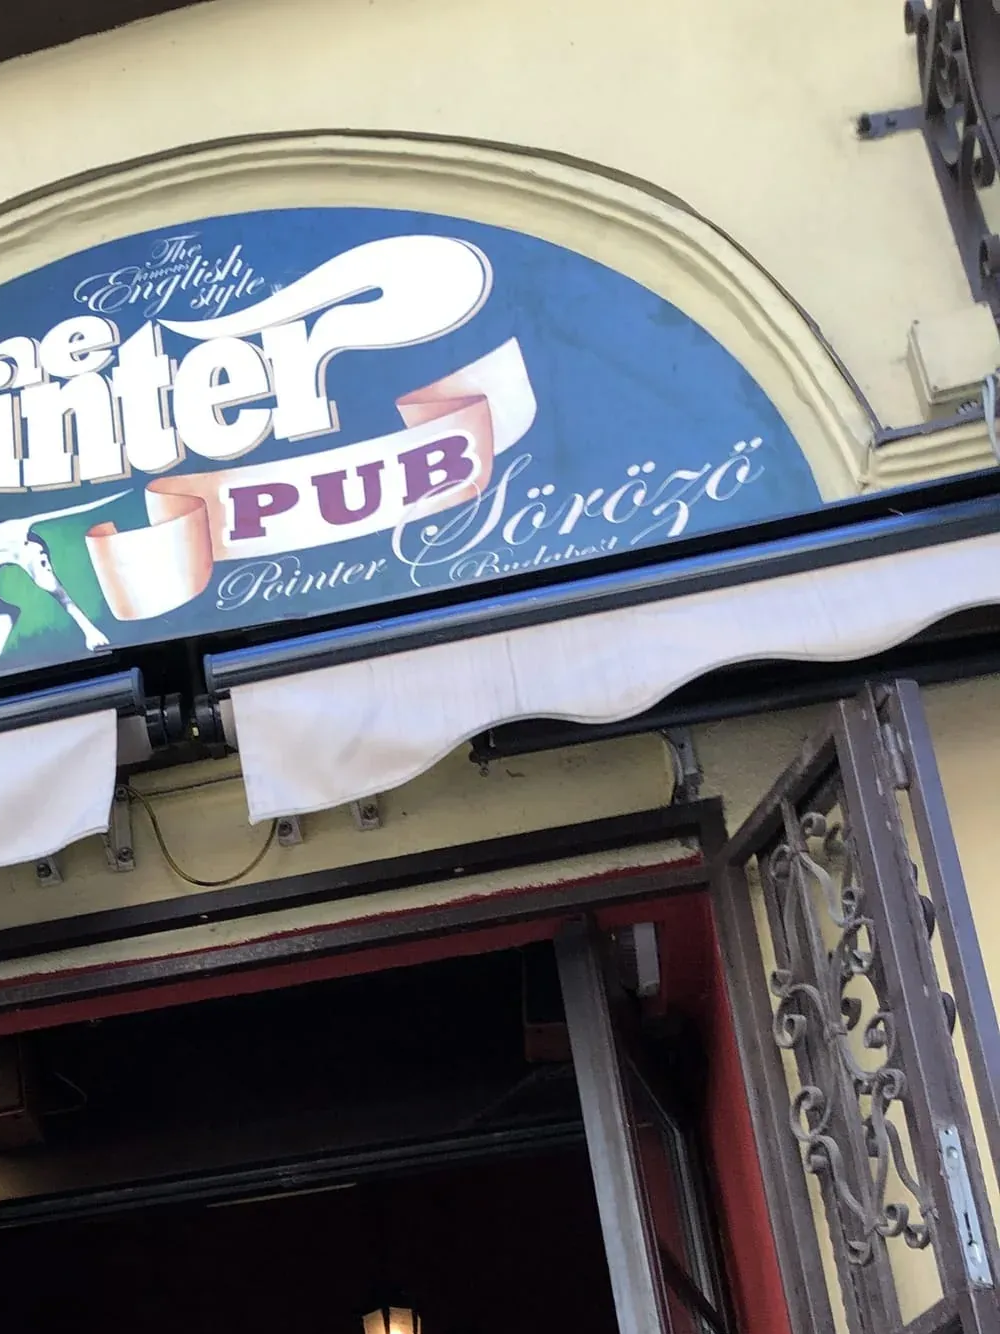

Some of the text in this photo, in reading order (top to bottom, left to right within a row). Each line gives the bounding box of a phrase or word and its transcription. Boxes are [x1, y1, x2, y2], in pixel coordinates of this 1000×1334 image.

[147, 231, 202, 268] The
[73, 244, 243, 318] English
[189, 267, 264, 321] style
[229, 435, 474, 541] PUB
[216, 555, 387, 611] Pointer
